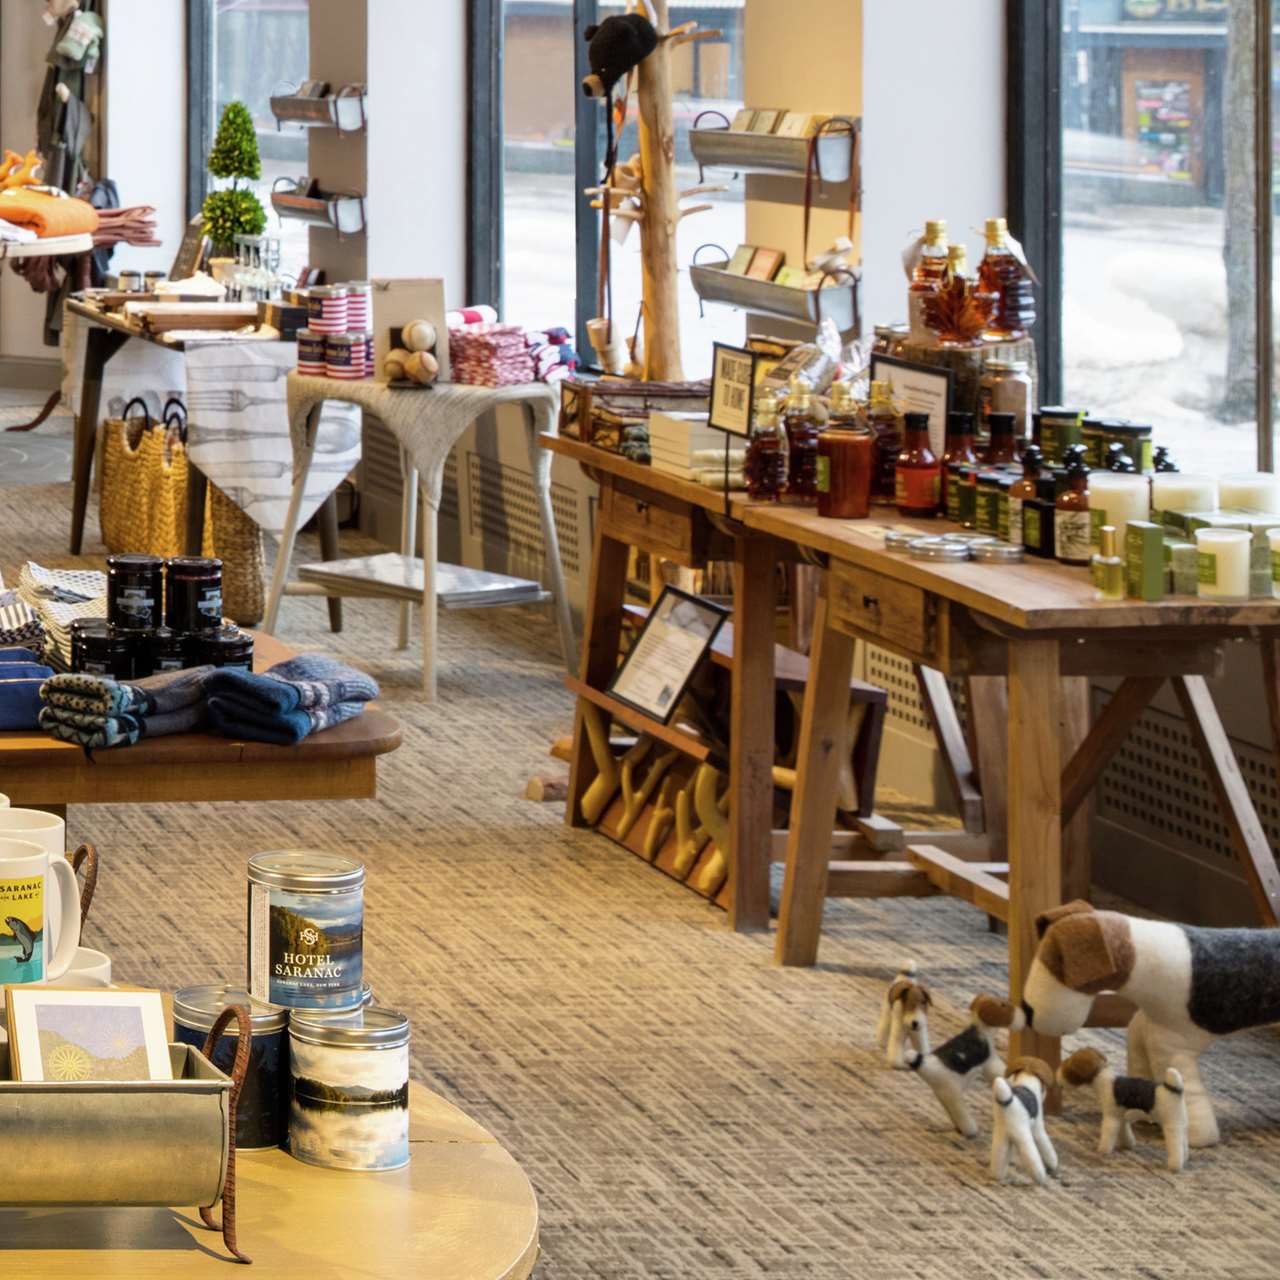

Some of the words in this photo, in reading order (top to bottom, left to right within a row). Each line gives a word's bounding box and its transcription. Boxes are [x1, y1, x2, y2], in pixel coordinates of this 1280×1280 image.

[0, 881, 42, 893] SARANAC
[12, 893, 34, 901] LAKE
[284, 952, 335, 966] HOTEL
[275, 964, 343, 978] SARANAC
